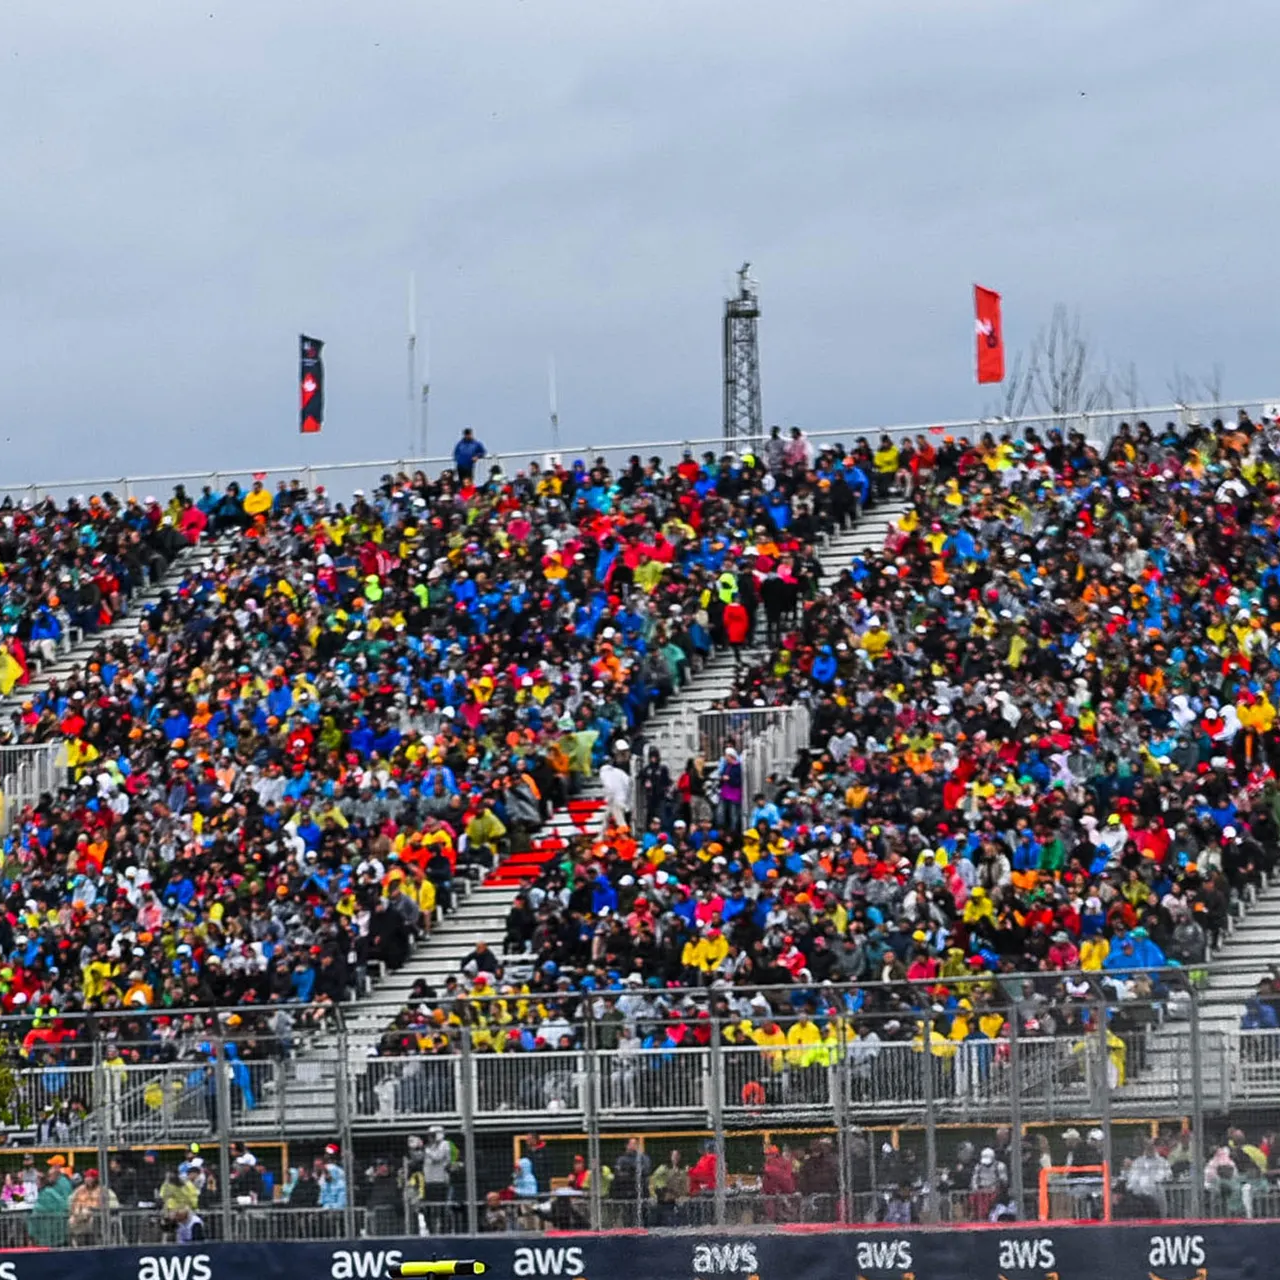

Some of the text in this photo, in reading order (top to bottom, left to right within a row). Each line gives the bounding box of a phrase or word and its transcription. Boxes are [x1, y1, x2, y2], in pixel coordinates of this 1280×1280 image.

[514, 1248, 583, 1275] aws
[694, 1244, 757, 1272] aws
[858, 1241, 911, 1269] aws
[1000, 1239, 1054, 1268] aws
[1150, 1236, 1204, 1266] aws
